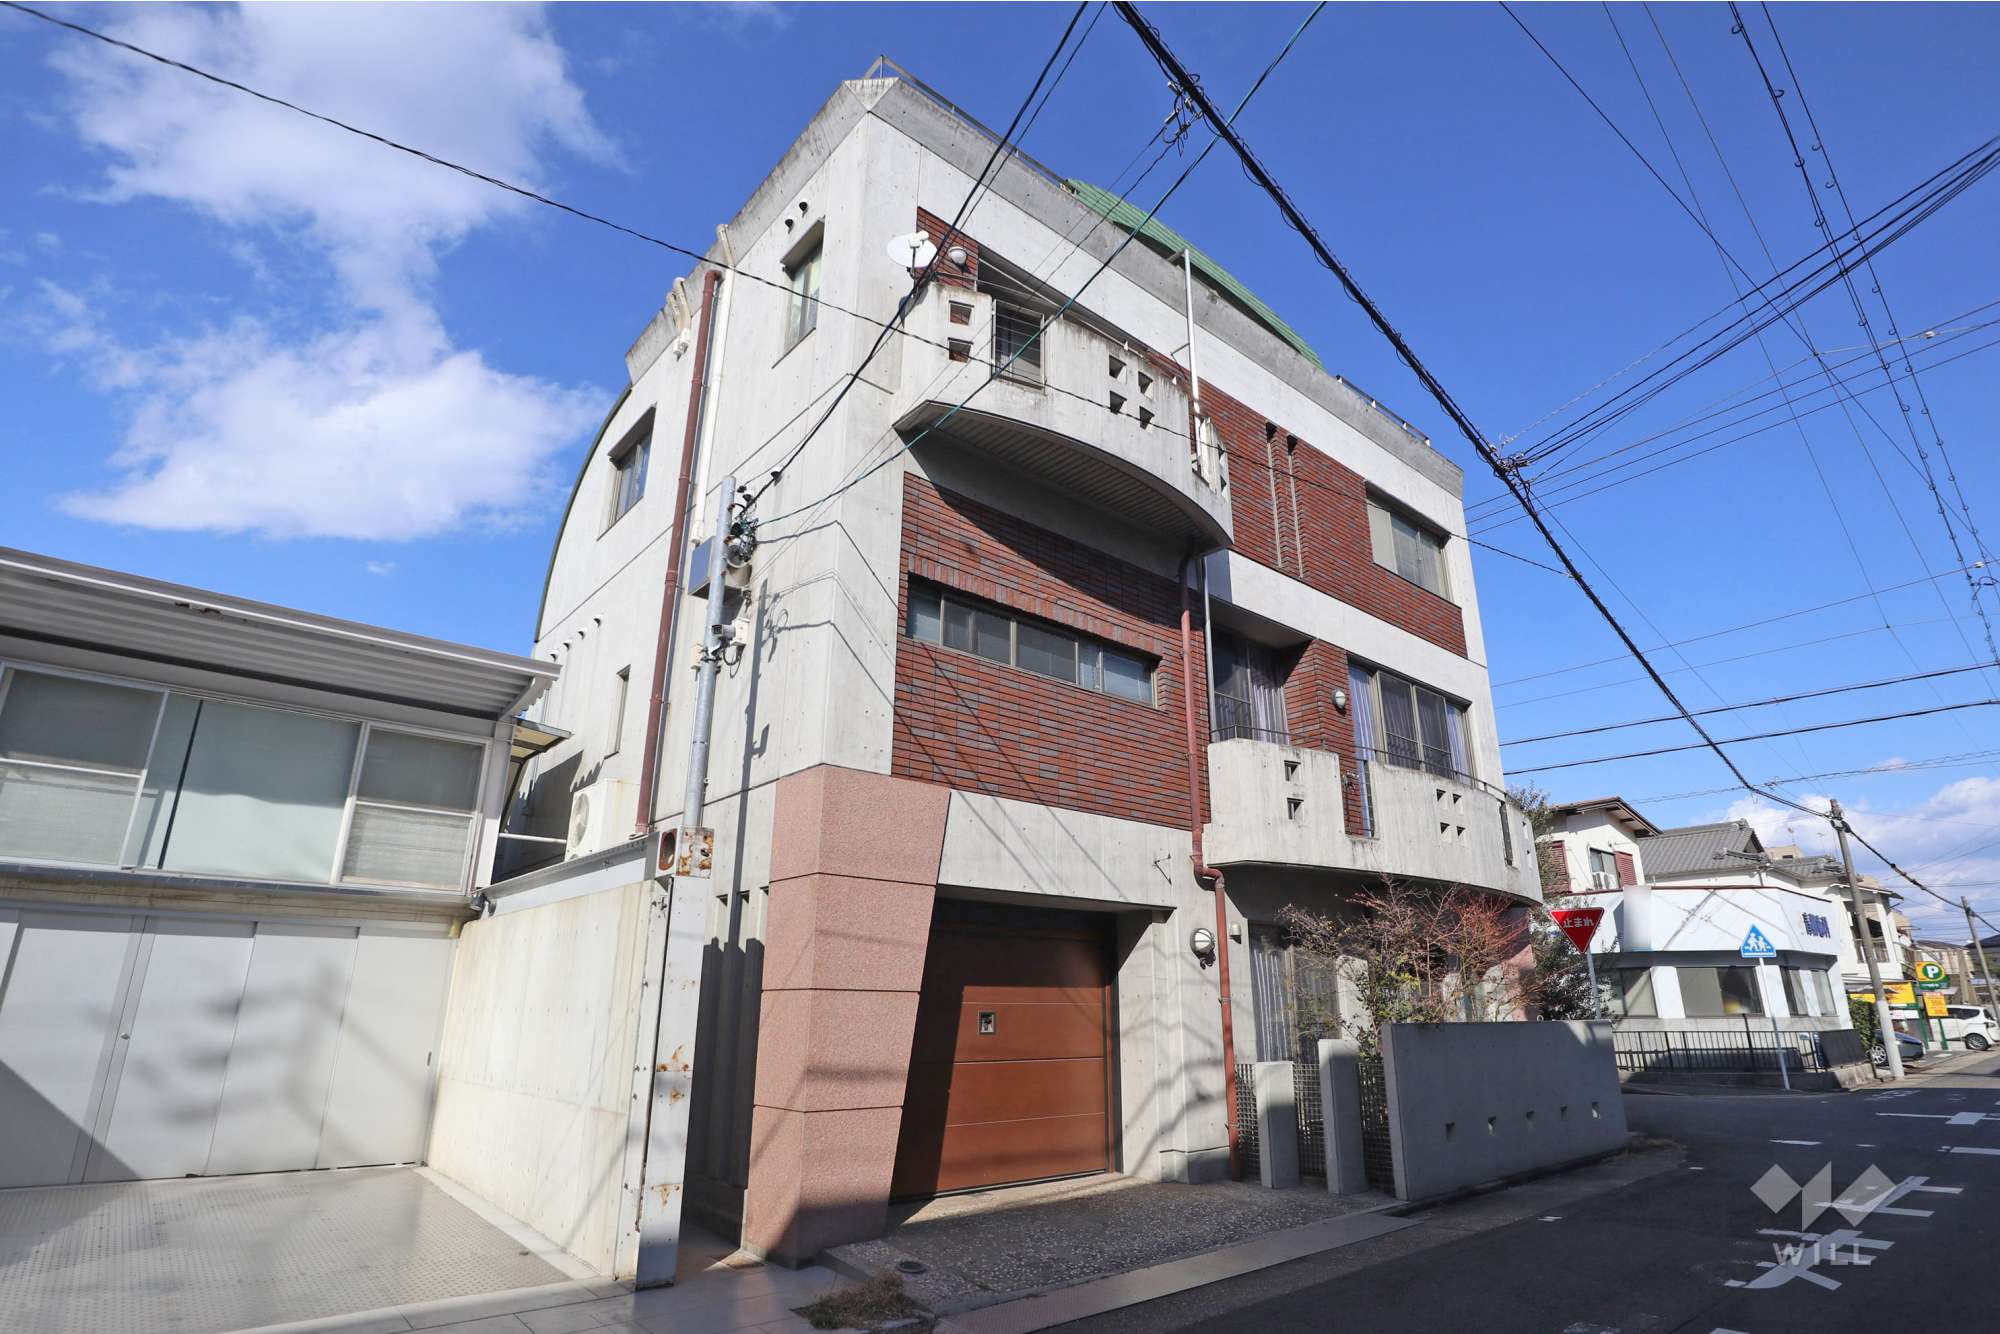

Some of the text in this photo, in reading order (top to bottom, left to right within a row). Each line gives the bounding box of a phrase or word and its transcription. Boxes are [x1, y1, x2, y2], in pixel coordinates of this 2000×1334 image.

[1563, 917, 1594, 928] 止まれ
[1925, 965, 1940, 979] P
